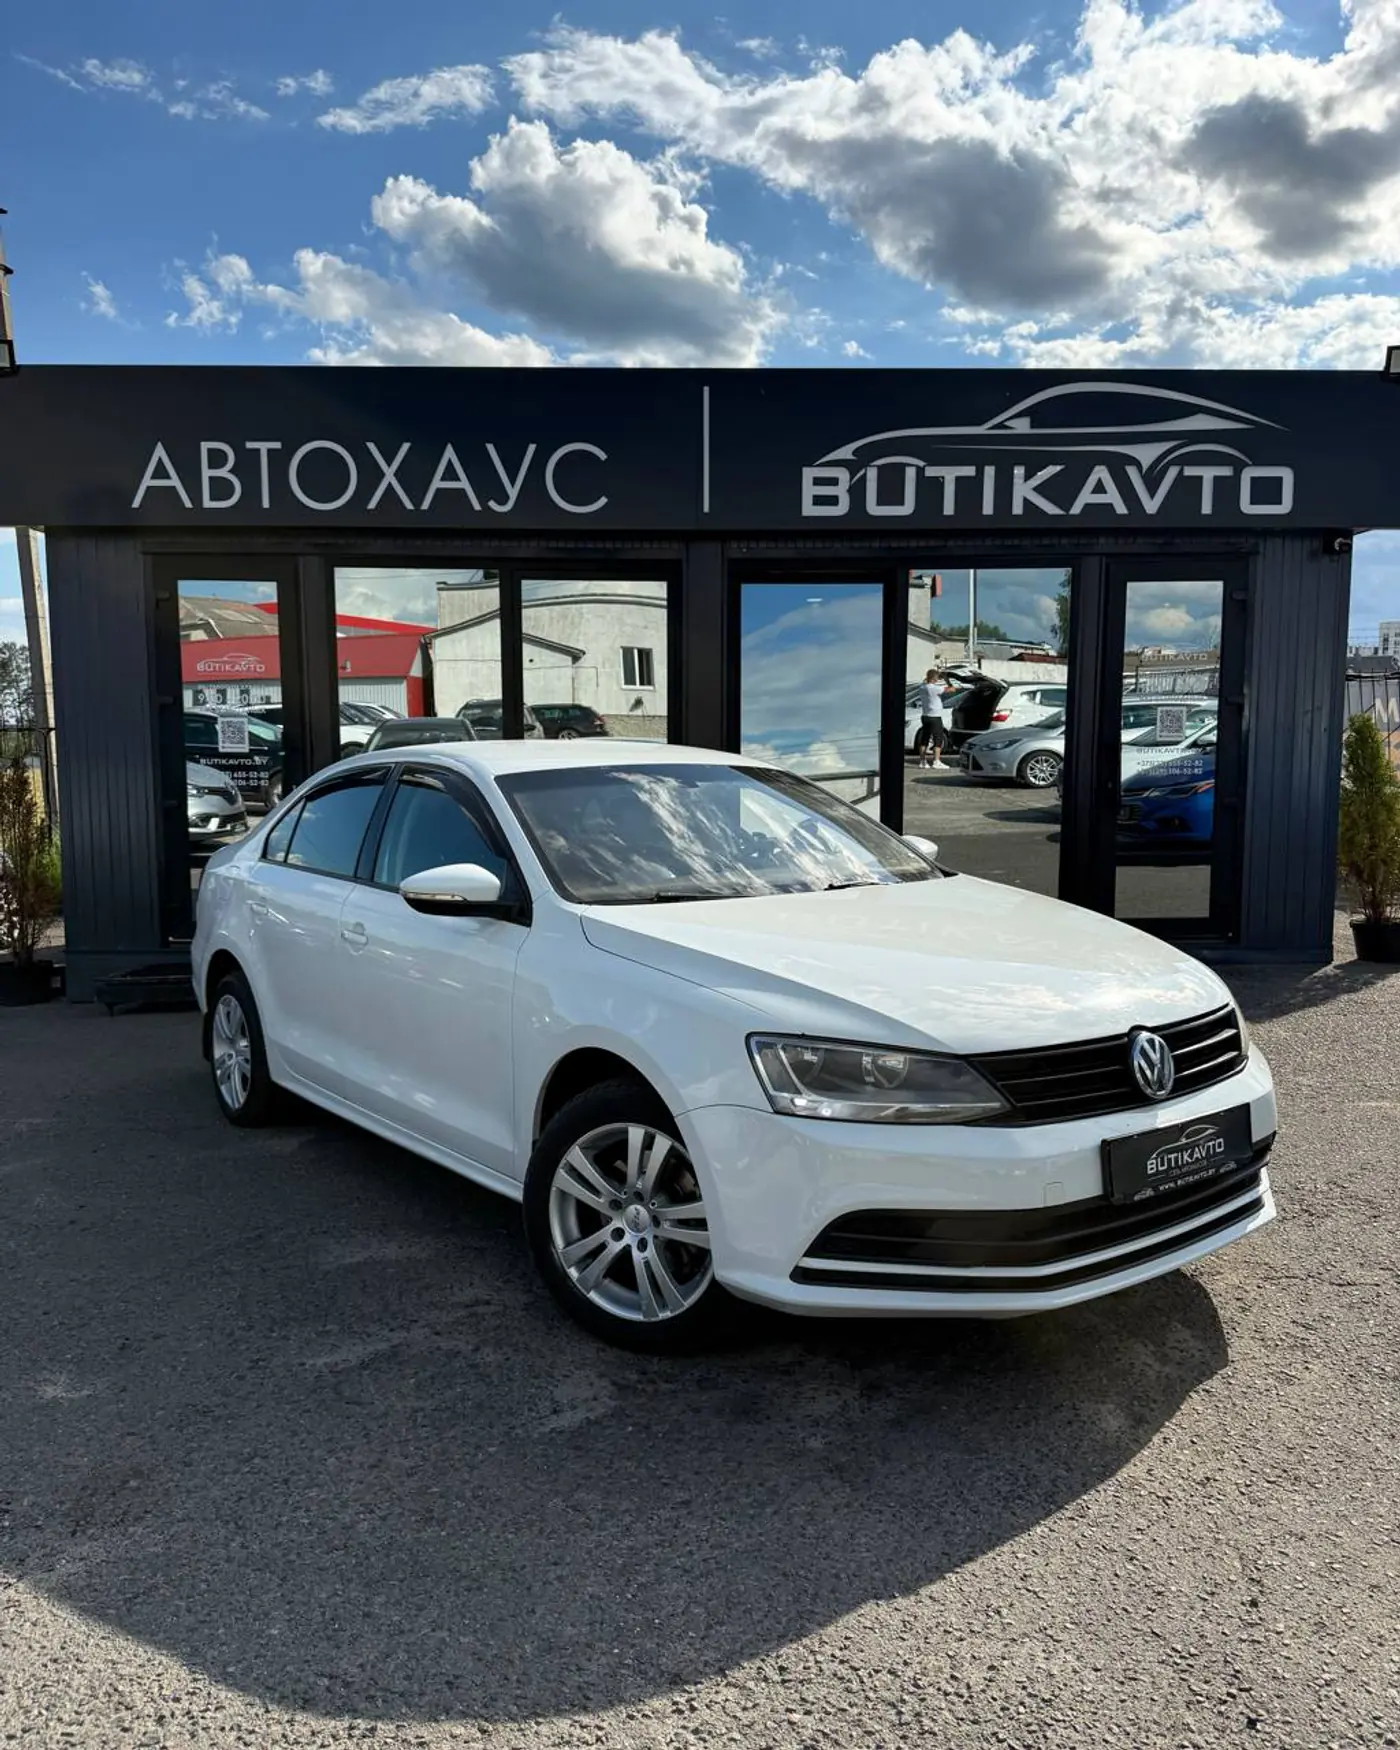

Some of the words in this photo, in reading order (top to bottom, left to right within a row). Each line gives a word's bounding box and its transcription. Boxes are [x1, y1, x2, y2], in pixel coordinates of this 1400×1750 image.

[131, 440, 609, 513] АВТОХАУС
[801, 464, 1295, 517] BUTIKAVTO
[196, 662, 266, 672] BUTIKAVTO
[1147, 1138, 1225, 1174] BUTIKAVTO
